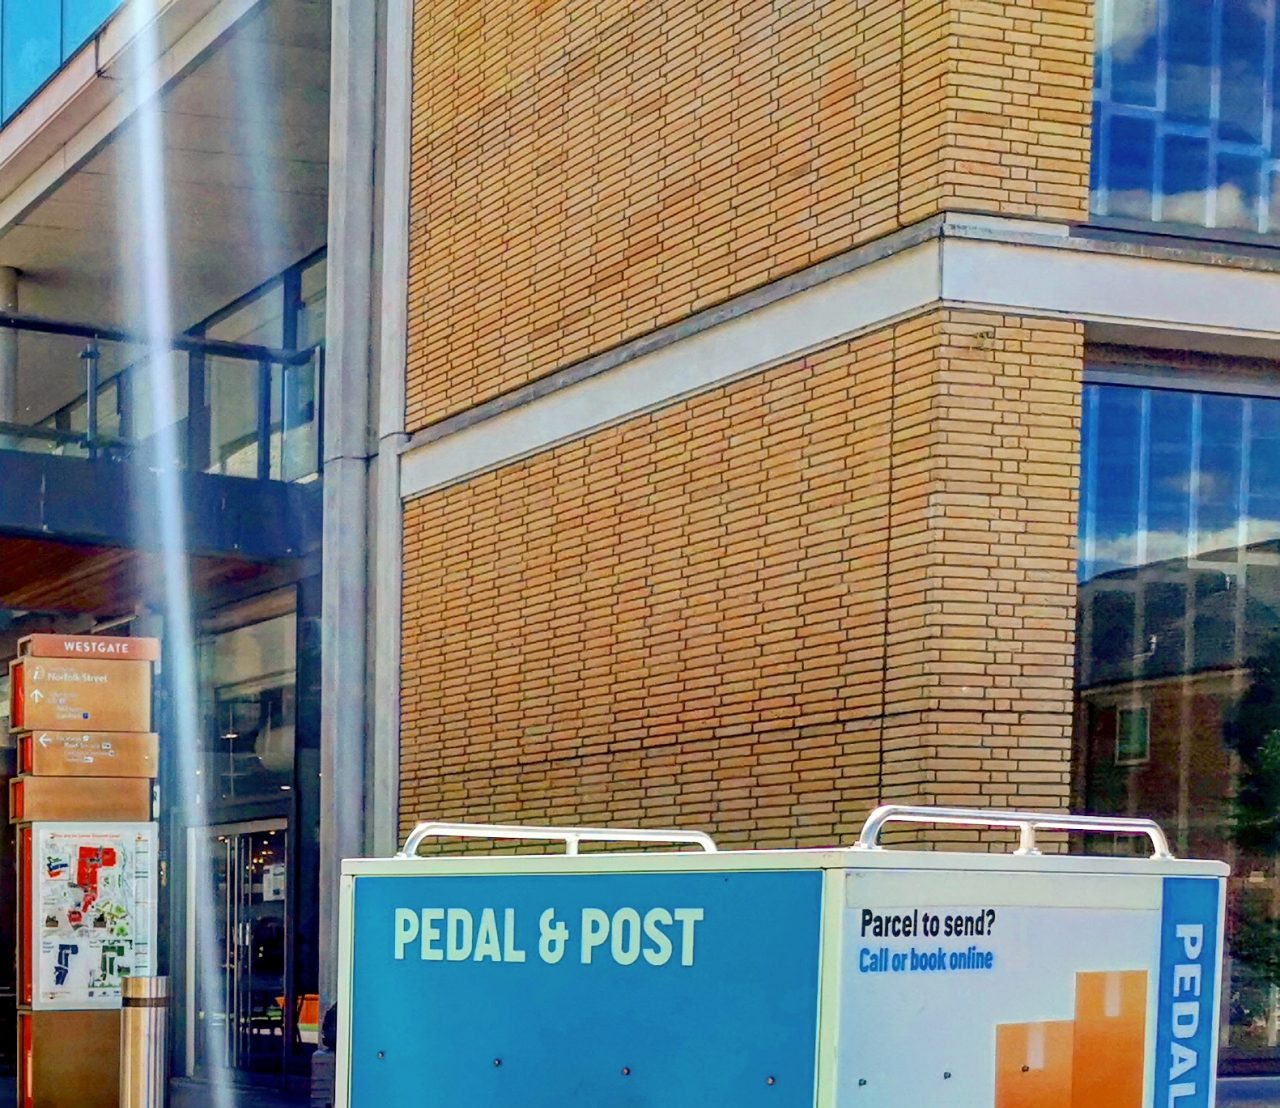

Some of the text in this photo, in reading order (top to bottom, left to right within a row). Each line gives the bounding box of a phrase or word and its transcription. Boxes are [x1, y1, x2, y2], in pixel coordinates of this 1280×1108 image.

[64, 641, 129, 654] WESTGATE
[47, 672, 108, 683] Norfolk Street
[394, 906, 704, 967] PEDAL & POST
[860, 908, 996, 938] Parcel to send?
[859, 945, 994, 973] Call or book online
